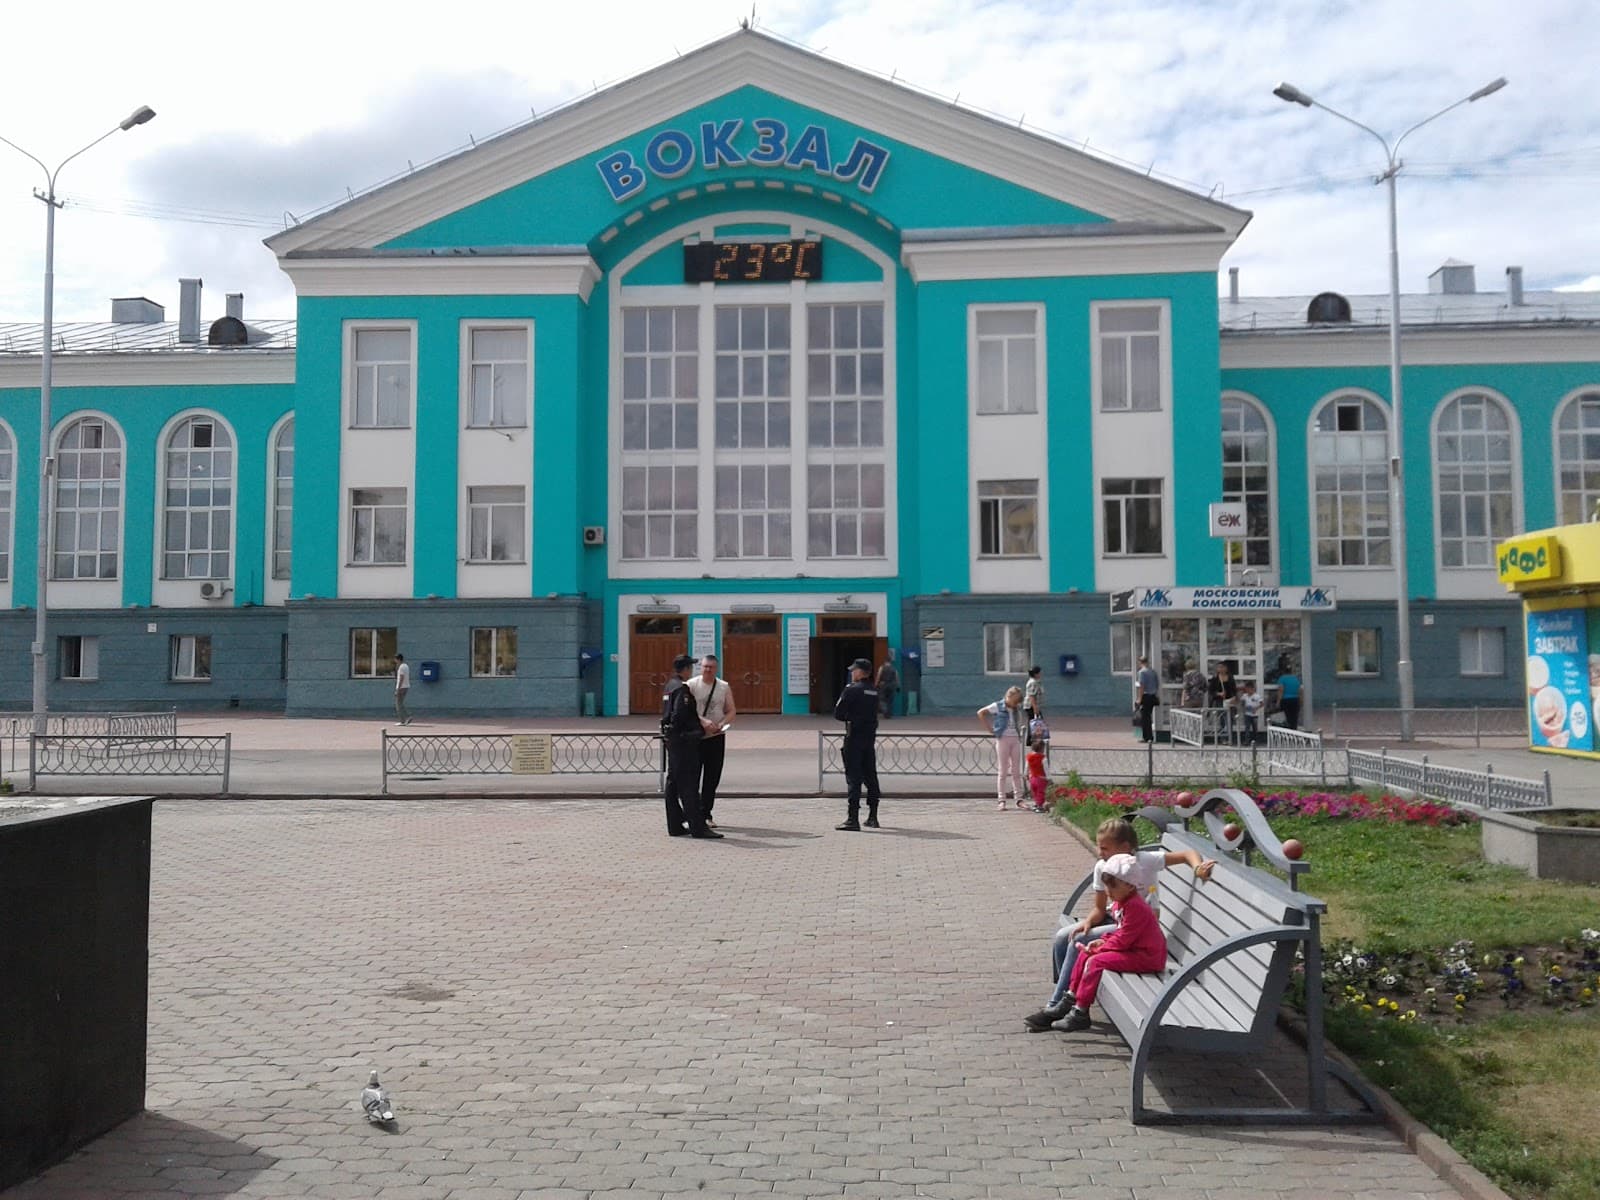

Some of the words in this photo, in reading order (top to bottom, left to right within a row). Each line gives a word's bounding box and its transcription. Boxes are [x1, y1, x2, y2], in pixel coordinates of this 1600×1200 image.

[596, 118, 891, 202] ВОКЗАЛ
[1193, 588, 1280, 598] МОСКОВСКИЙ
[1192, 599, 1282, 609] КОМСОМОЛЕЦ
[1534, 636, 1579, 655] ЗАВТРАК
